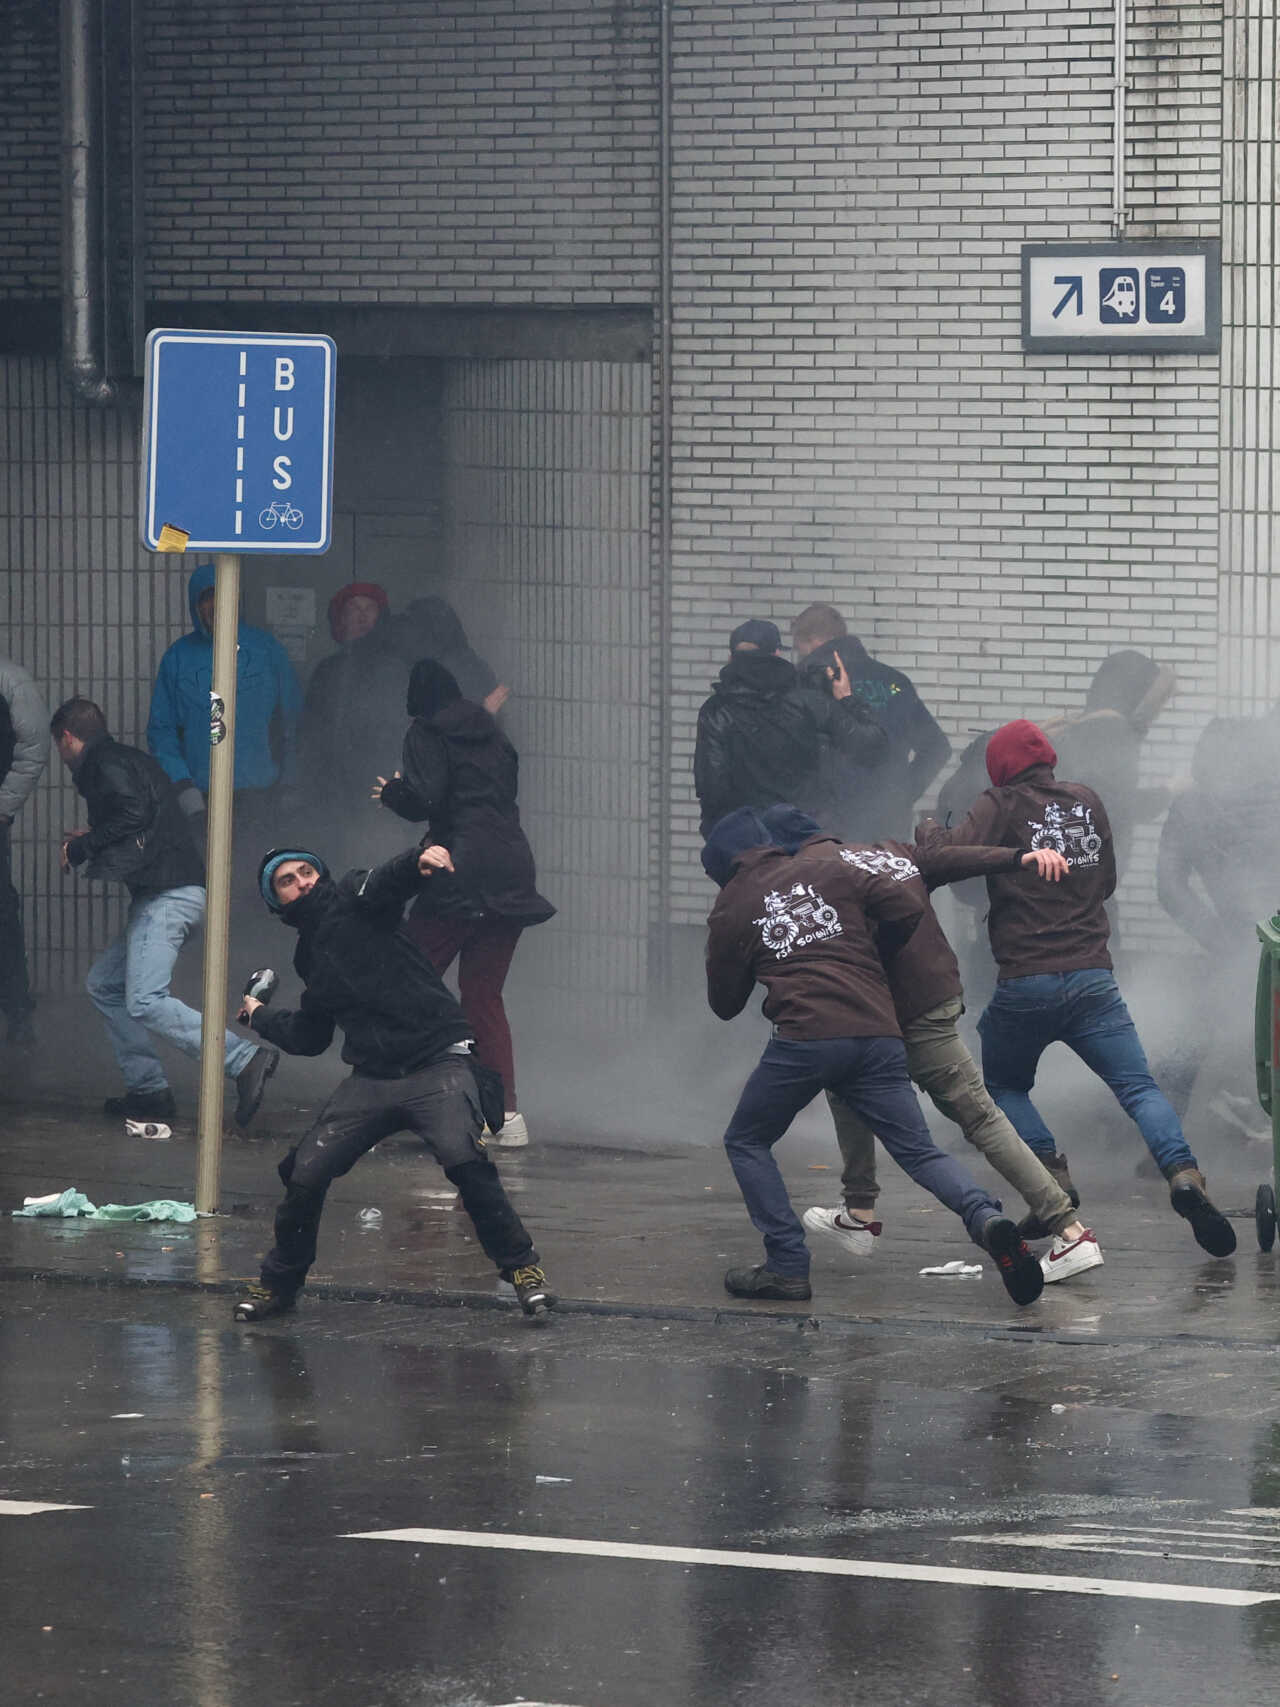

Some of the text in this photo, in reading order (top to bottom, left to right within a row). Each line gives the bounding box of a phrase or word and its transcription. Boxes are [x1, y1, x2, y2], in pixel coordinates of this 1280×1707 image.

[1159, 290, 1176, 315] 4
[272, 357, 296, 491] BUS
[1066, 853, 1100, 866] OIGNIES
